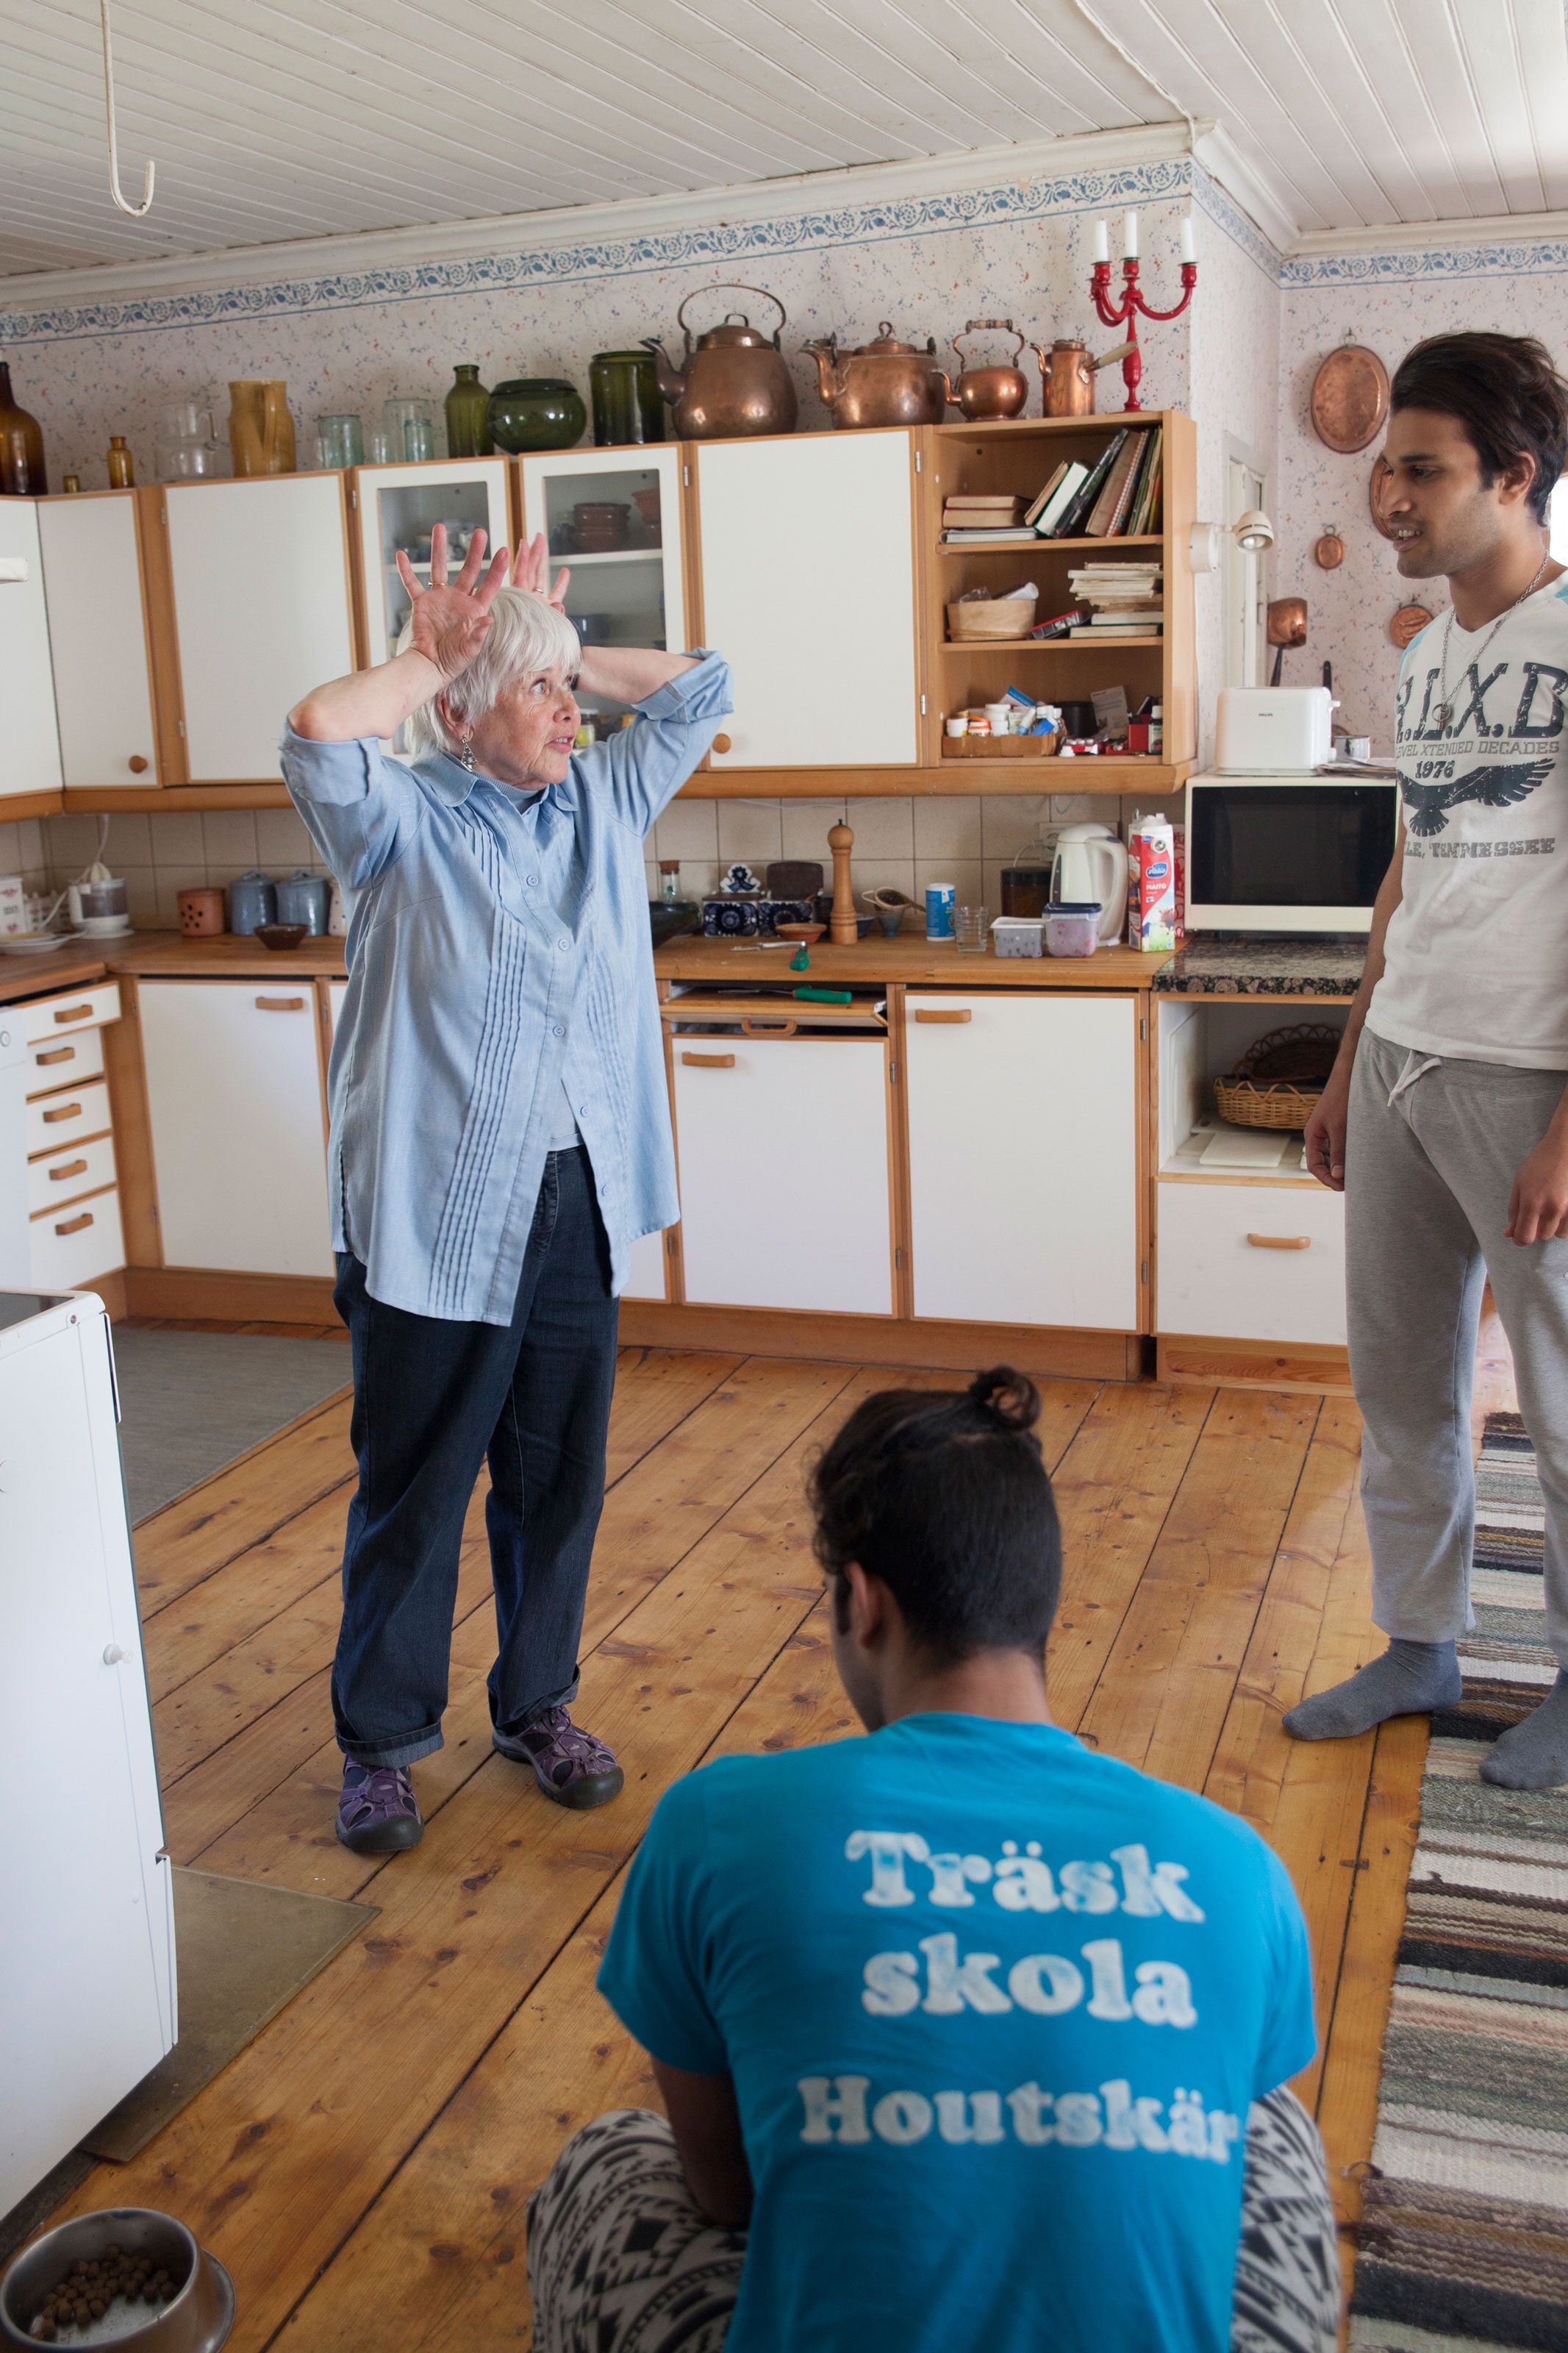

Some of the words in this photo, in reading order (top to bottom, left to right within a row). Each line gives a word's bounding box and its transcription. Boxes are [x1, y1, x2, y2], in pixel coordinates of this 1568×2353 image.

[1395, 744, 1418, 760] EVEL
[1477, 740, 1560, 755] DECADES
[1415, 760, 1456, 779] 1976
[845, 1829, 1206, 1923] Träsk
[861, 1932, 1198, 2029] skola
[797, 2074, 1240, 2164] Houtskär
